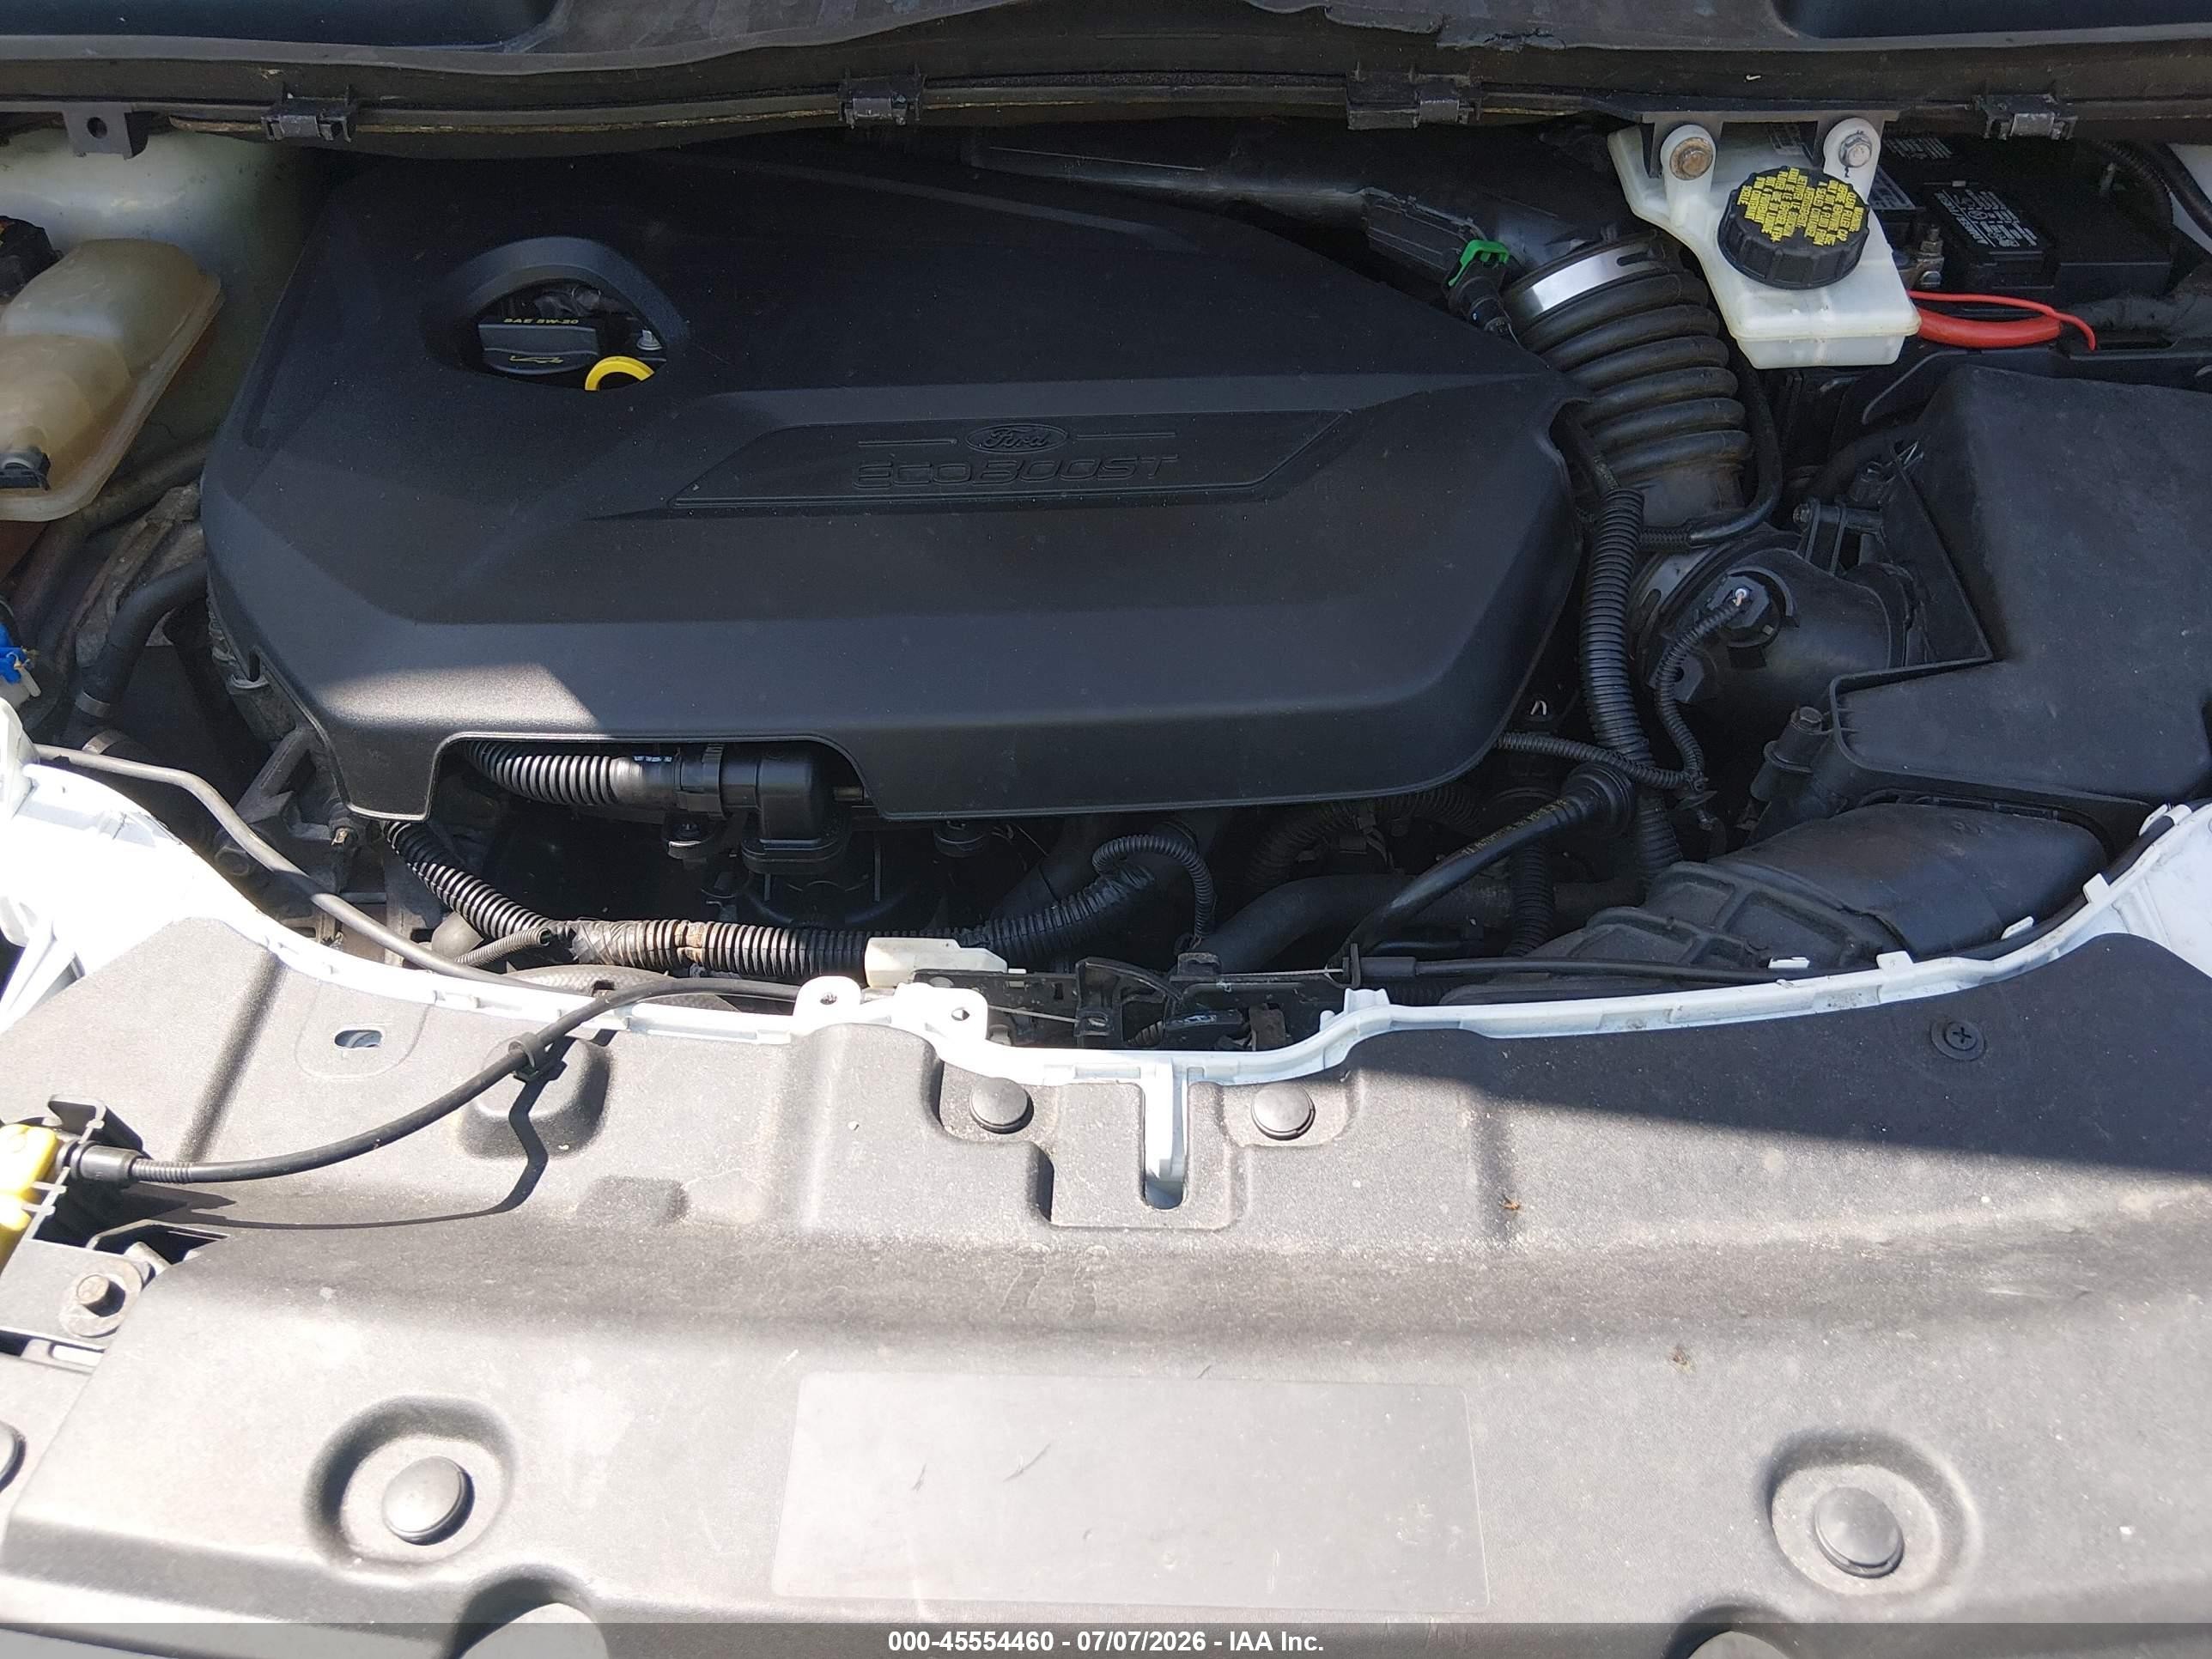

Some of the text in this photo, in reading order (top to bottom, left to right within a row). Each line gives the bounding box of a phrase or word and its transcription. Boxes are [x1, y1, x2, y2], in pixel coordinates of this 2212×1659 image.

[1765, 176, 1776, 187] DOT
[1785, 184, 1795, 192] DE
[1828, 180, 1838, 194] ONLY
[1771, 191, 1782, 202] QUE
[1814, 187, 1827, 206] SEALED
[1825, 195, 1835, 205] DOT
[1835, 184, 1848, 204] BEFORE
[1769, 203, 1779, 211] DU
[1819, 211, 1831, 228] FLUID
[1837, 192, 1856, 241] CLEAN FILLER CAP
[1814, 228, 1827, 246] FROM
[1825, 233, 1836, 246] USE
[853, 453, 1179, 489] ECOBOOST
